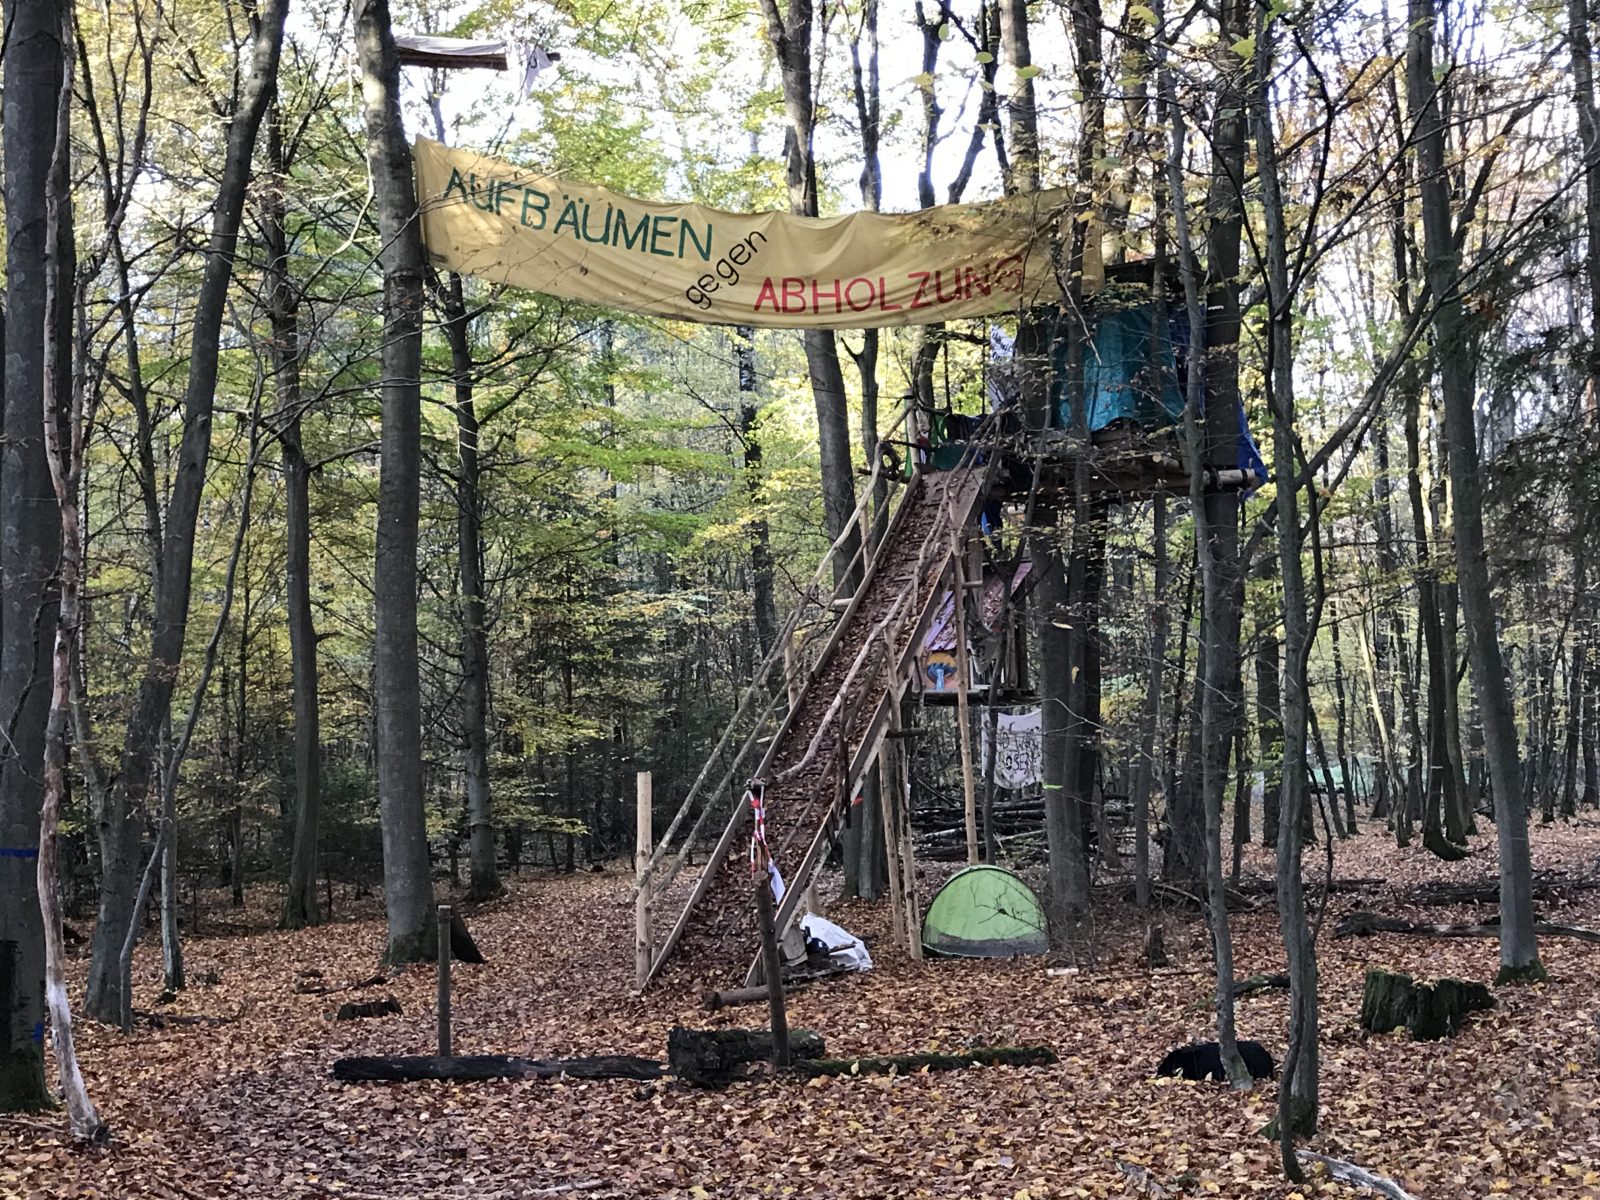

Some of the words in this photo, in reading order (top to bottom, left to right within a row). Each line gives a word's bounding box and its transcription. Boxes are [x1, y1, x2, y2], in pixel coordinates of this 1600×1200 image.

[443, 167, 713, 262] AUFBÄUMEN
[685, 230, 768, 310] gegen
[753, 254, 1023, 314] ABHOLZUNG
